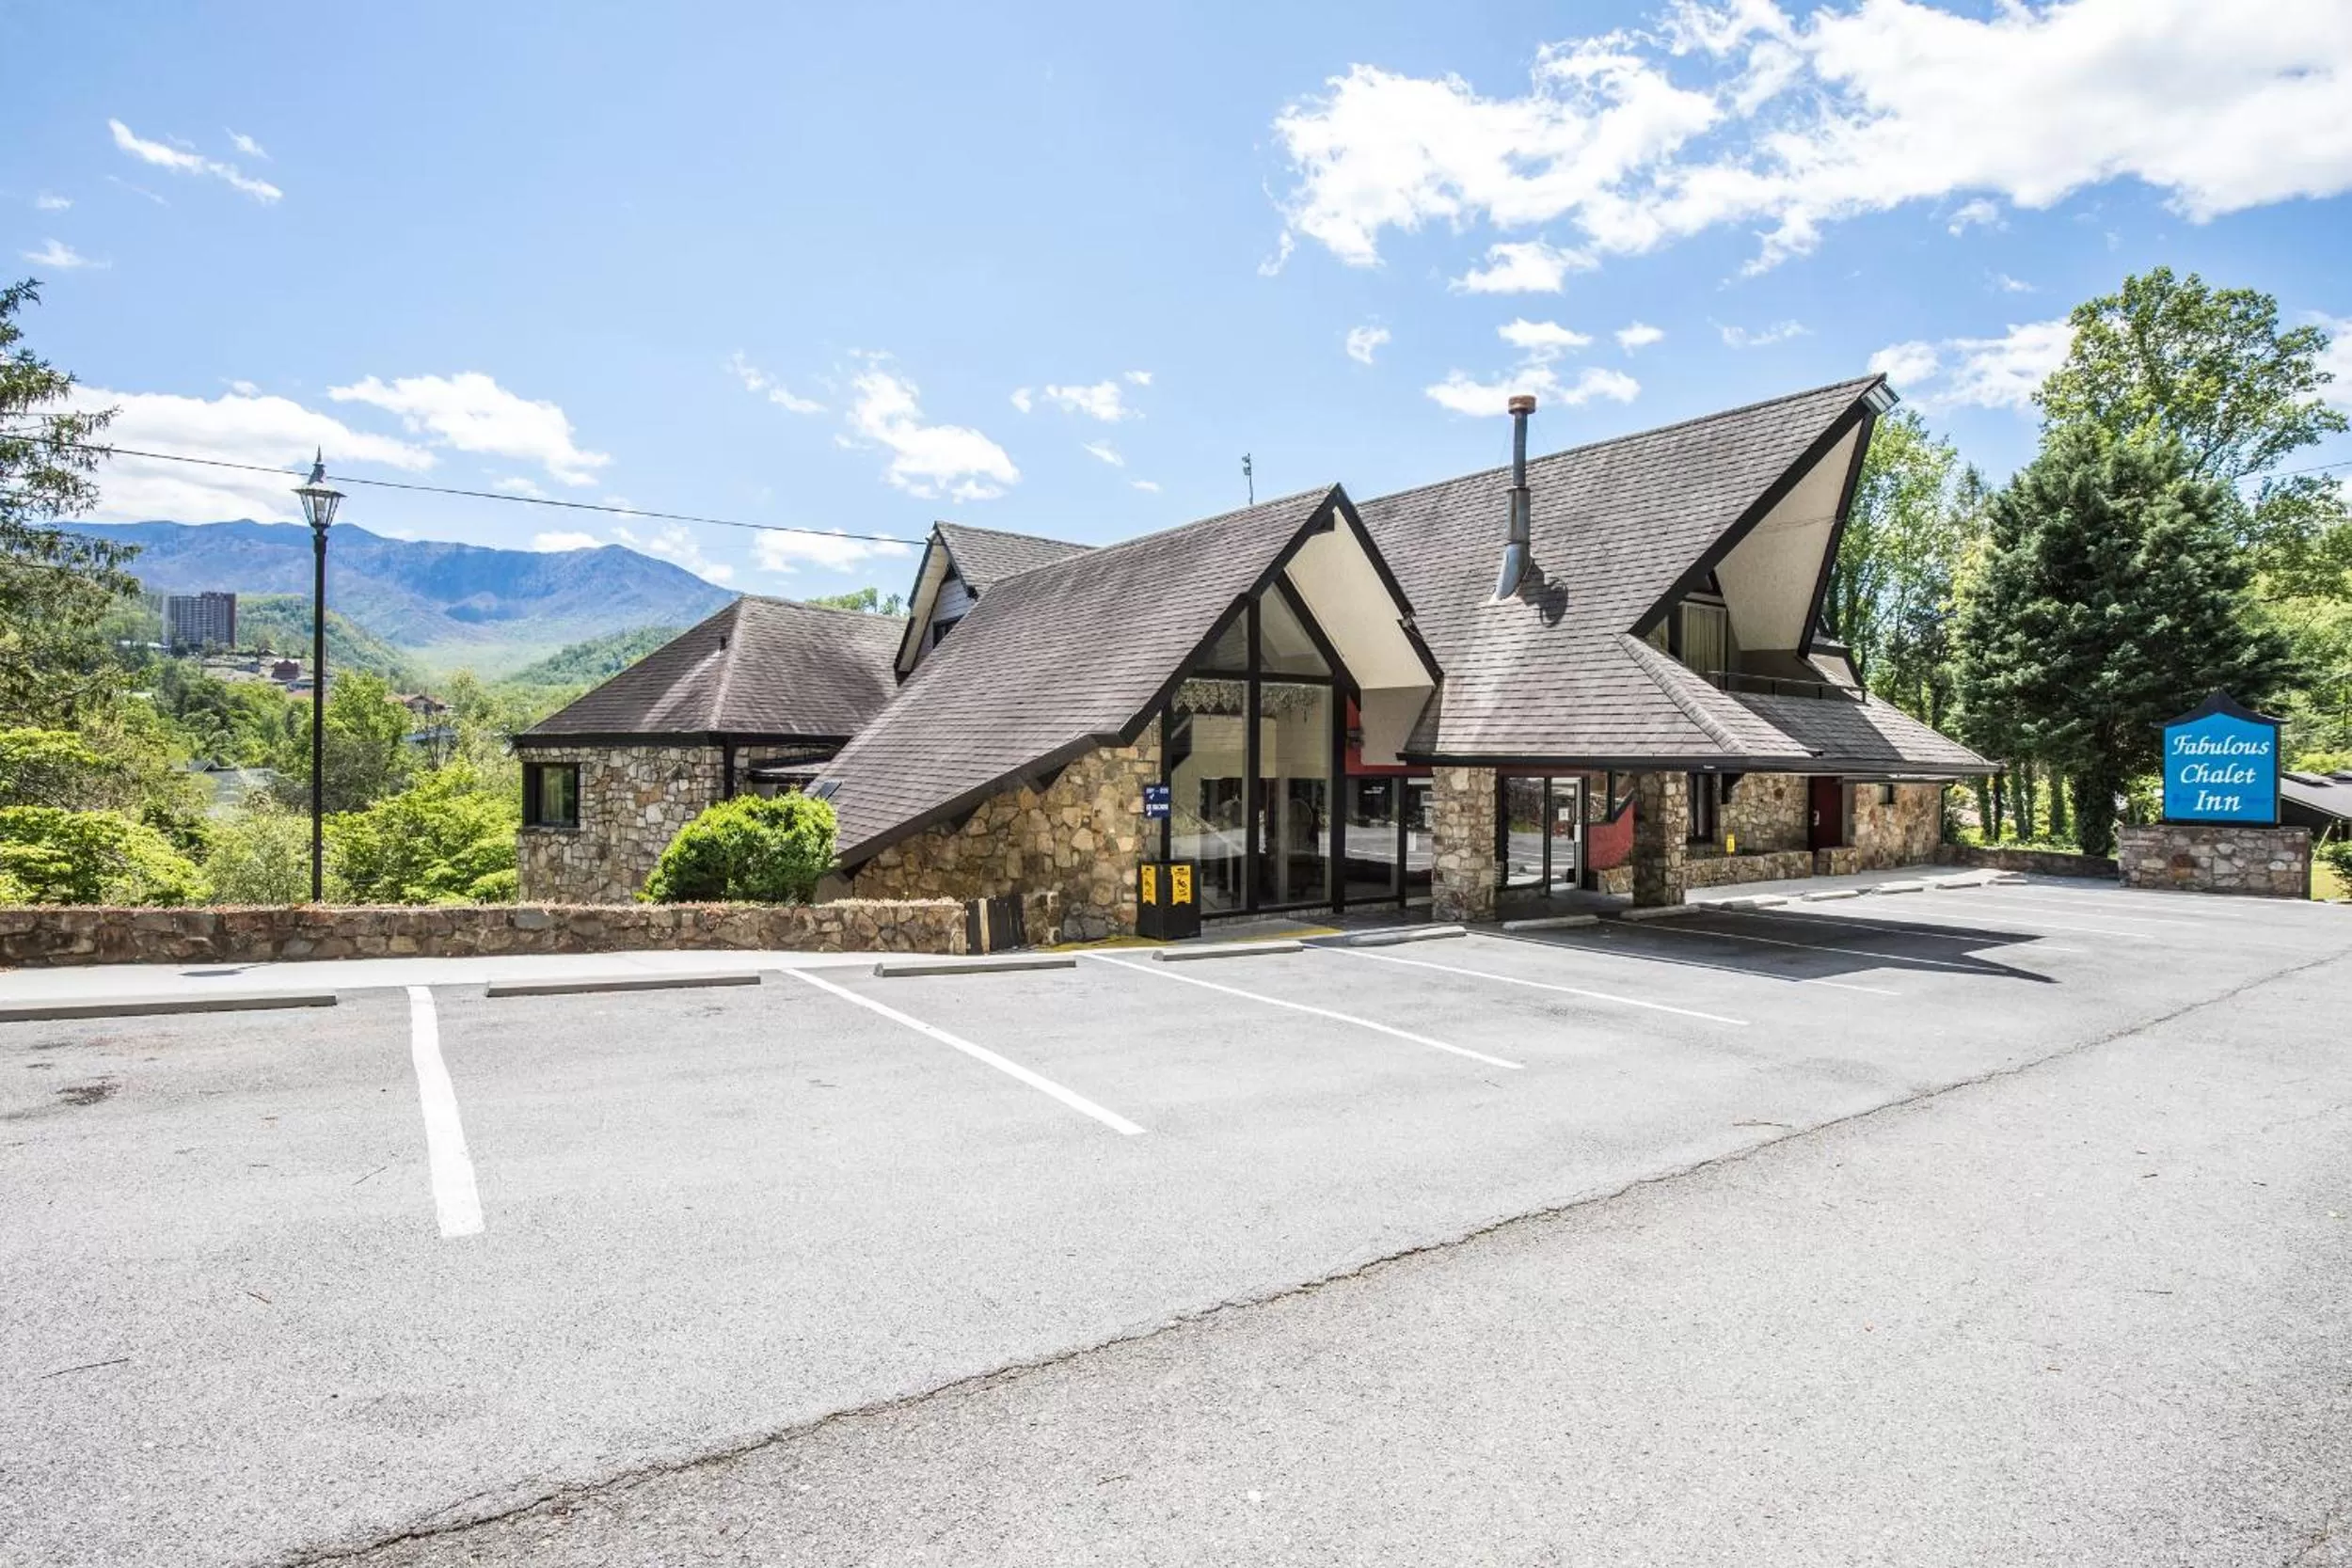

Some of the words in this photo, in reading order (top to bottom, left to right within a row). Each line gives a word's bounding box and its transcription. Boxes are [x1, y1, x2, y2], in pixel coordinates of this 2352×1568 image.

[2172, 735, 2270, 755] Fabulous
[2180, 763, 2256, 784] Chalet
[2194, 790, 2242, 812] Inn
